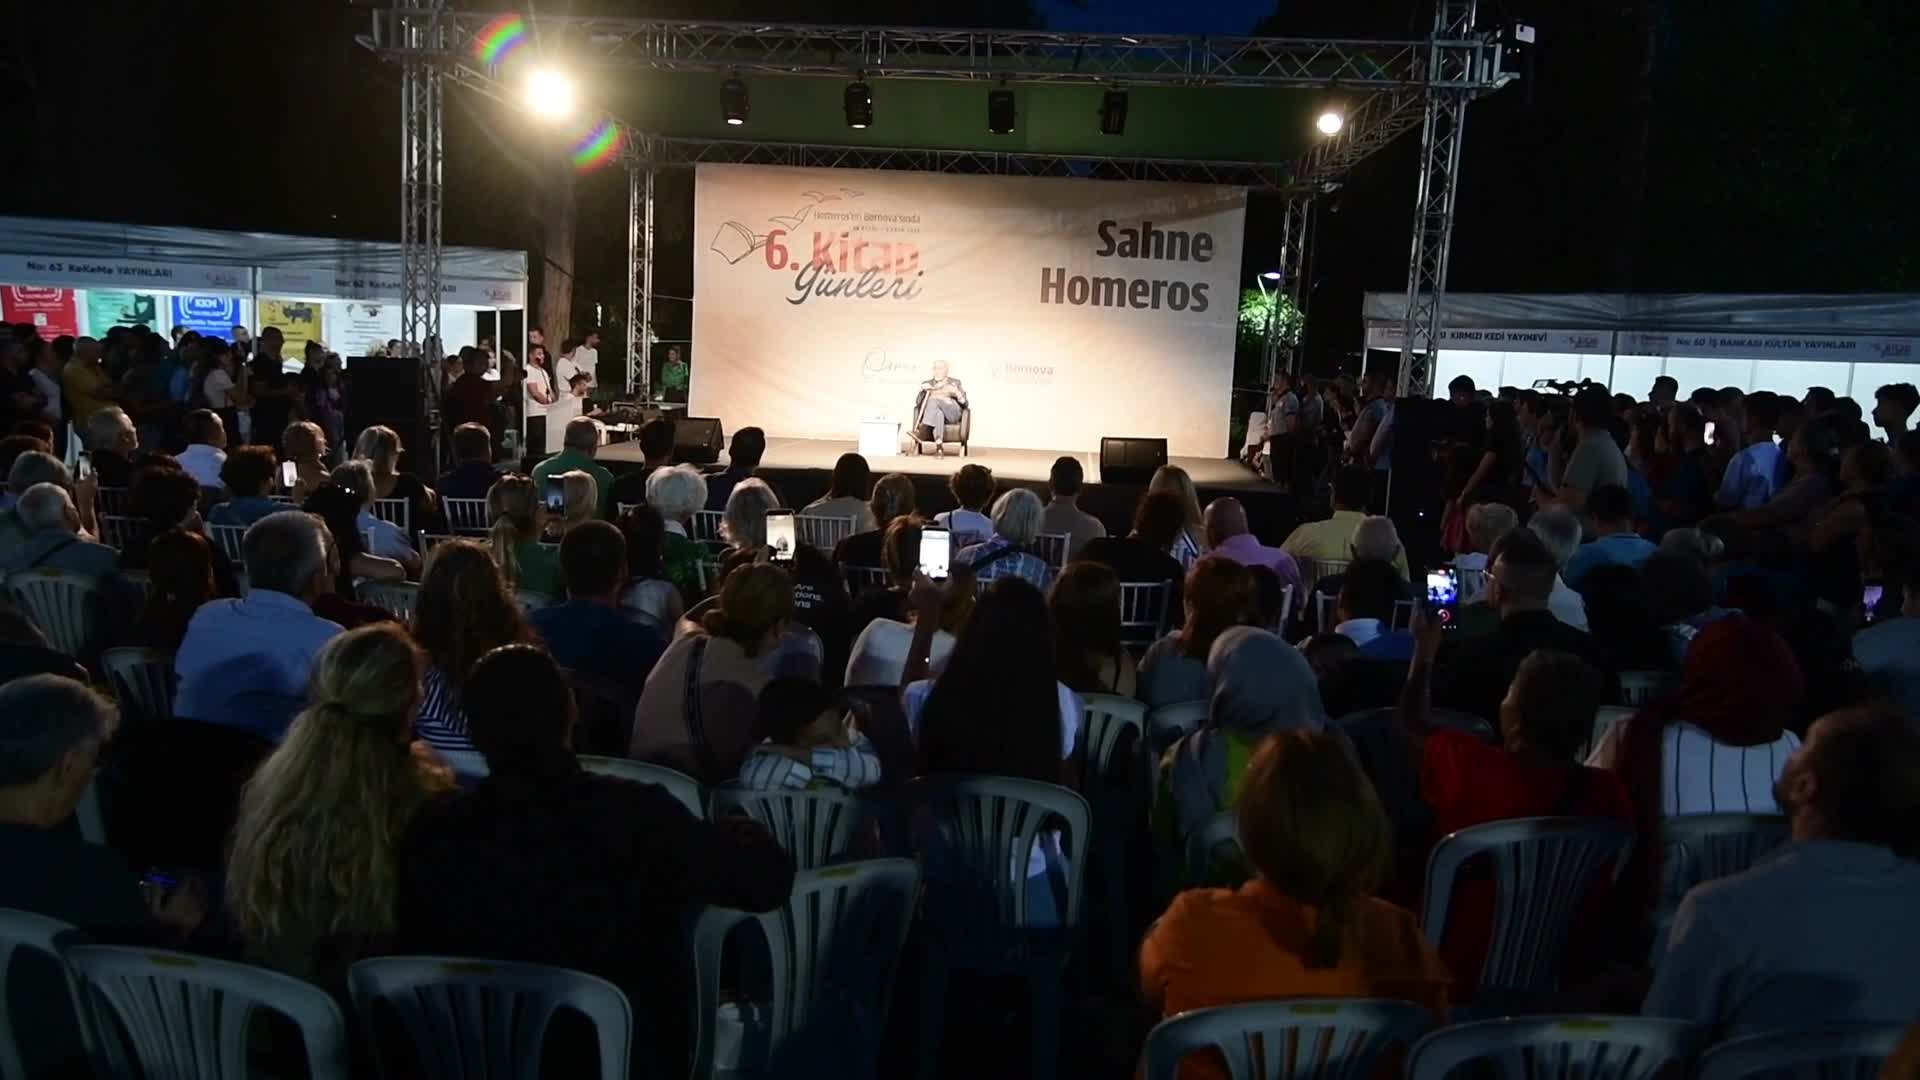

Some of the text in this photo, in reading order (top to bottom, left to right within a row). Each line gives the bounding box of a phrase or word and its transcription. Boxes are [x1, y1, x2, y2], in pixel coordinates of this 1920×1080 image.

[765, 229, 920, 277] 6. Kitap
[1096, 220, 1215, 262] Sahne
[117, 266, 173, 279] YAYINLARI
[785, 260, 924, 305] Günleri
[1040, 267, 1209, 312] Homeros
[1450, 331, 1482, 341] KIRMIZI
[1484, 331, 1504, 342] KEDİ
[1507, 331, 1547, 343] YAYINEVİ
